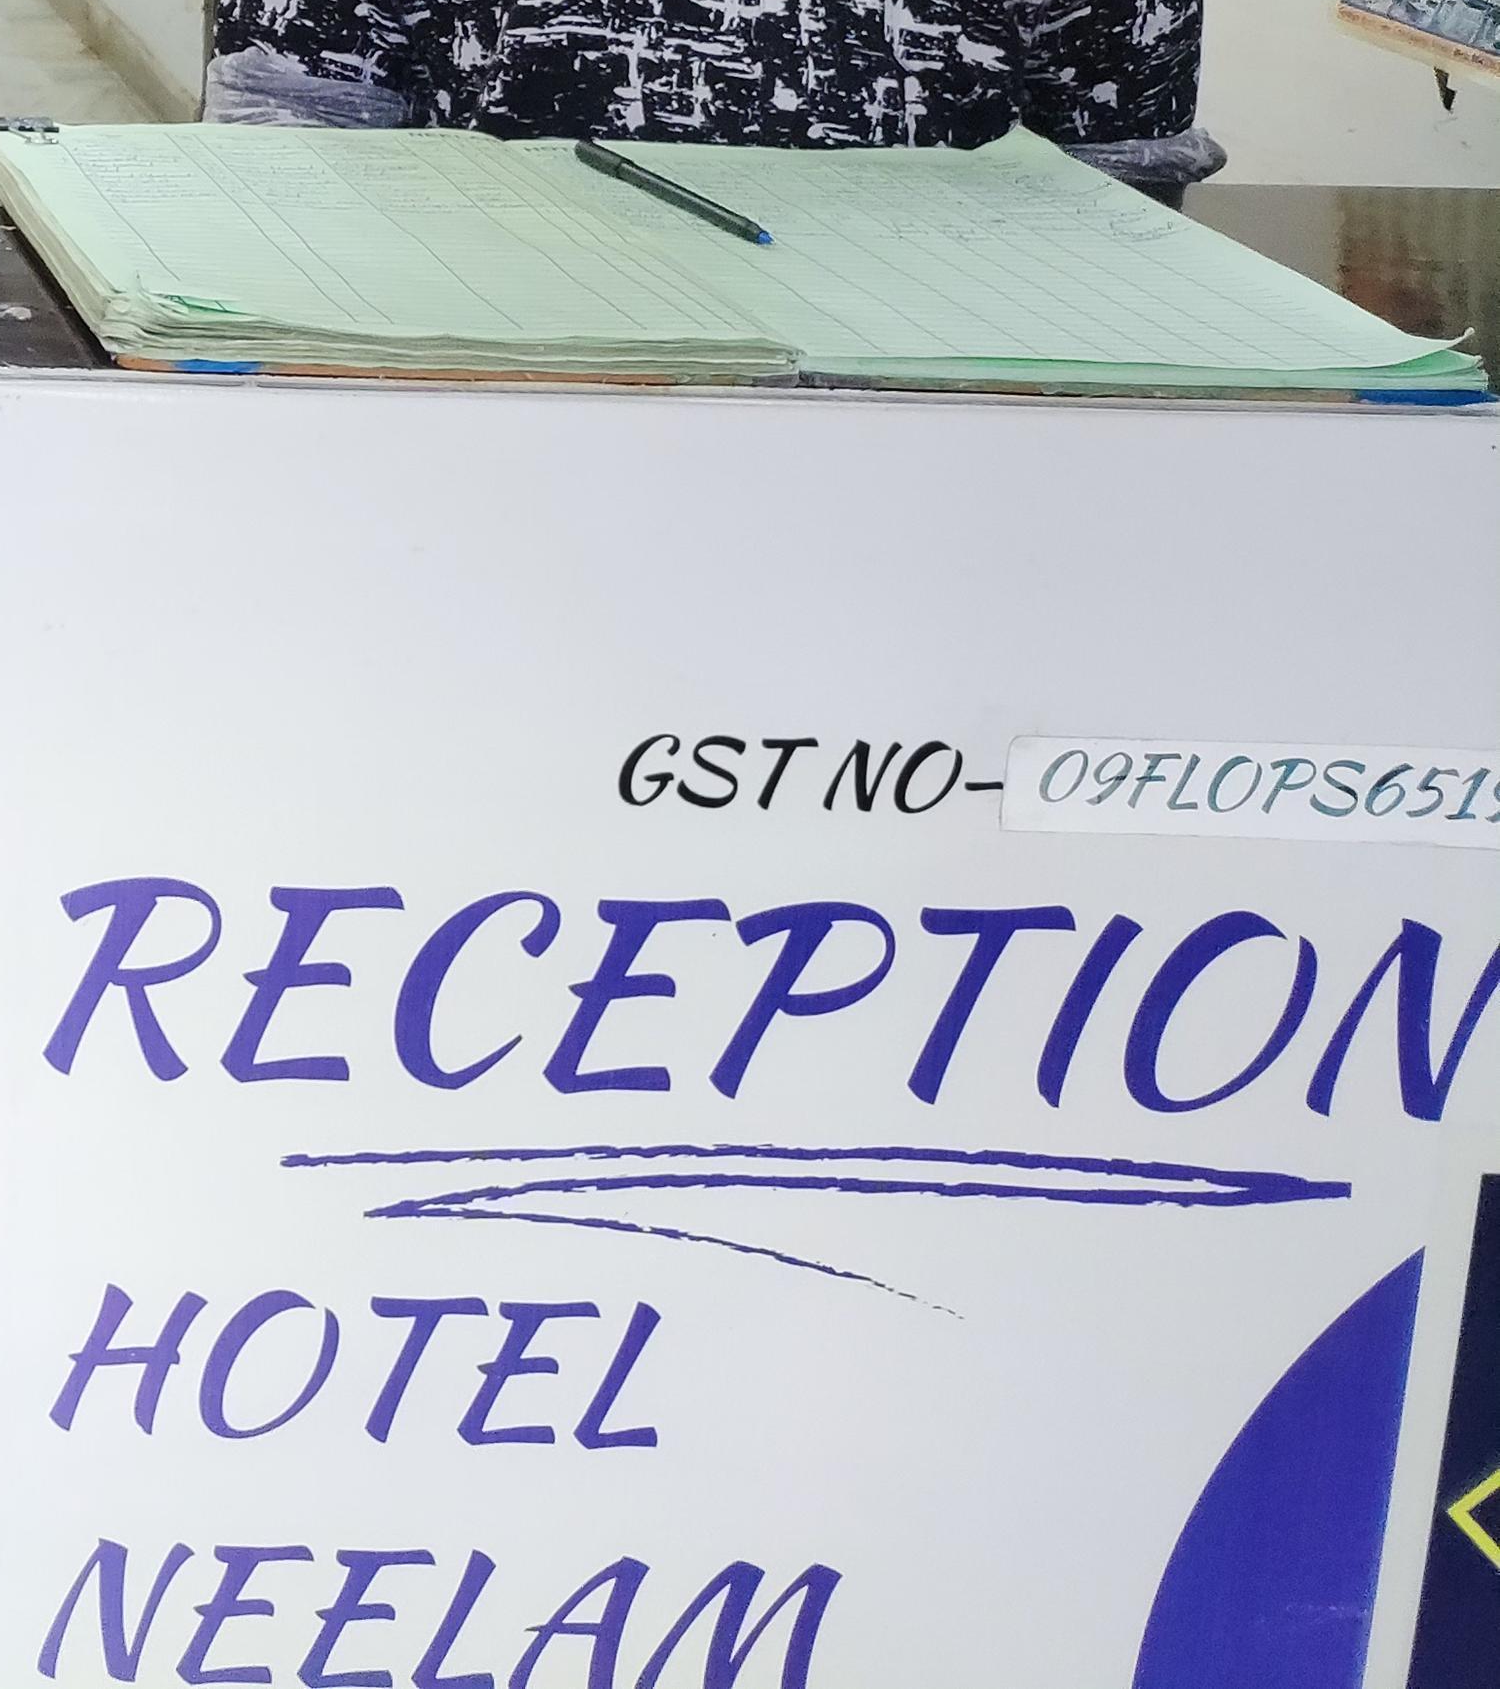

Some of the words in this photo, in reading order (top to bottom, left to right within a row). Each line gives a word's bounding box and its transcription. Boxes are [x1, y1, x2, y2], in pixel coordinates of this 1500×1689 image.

[617, 733, 818, 811] GST
[43, 877, 1500, 1123] RECEPTION
[50, 1285, 661, 1450] HOTEL
[38, 1539, 842, 1689] NEELAM
